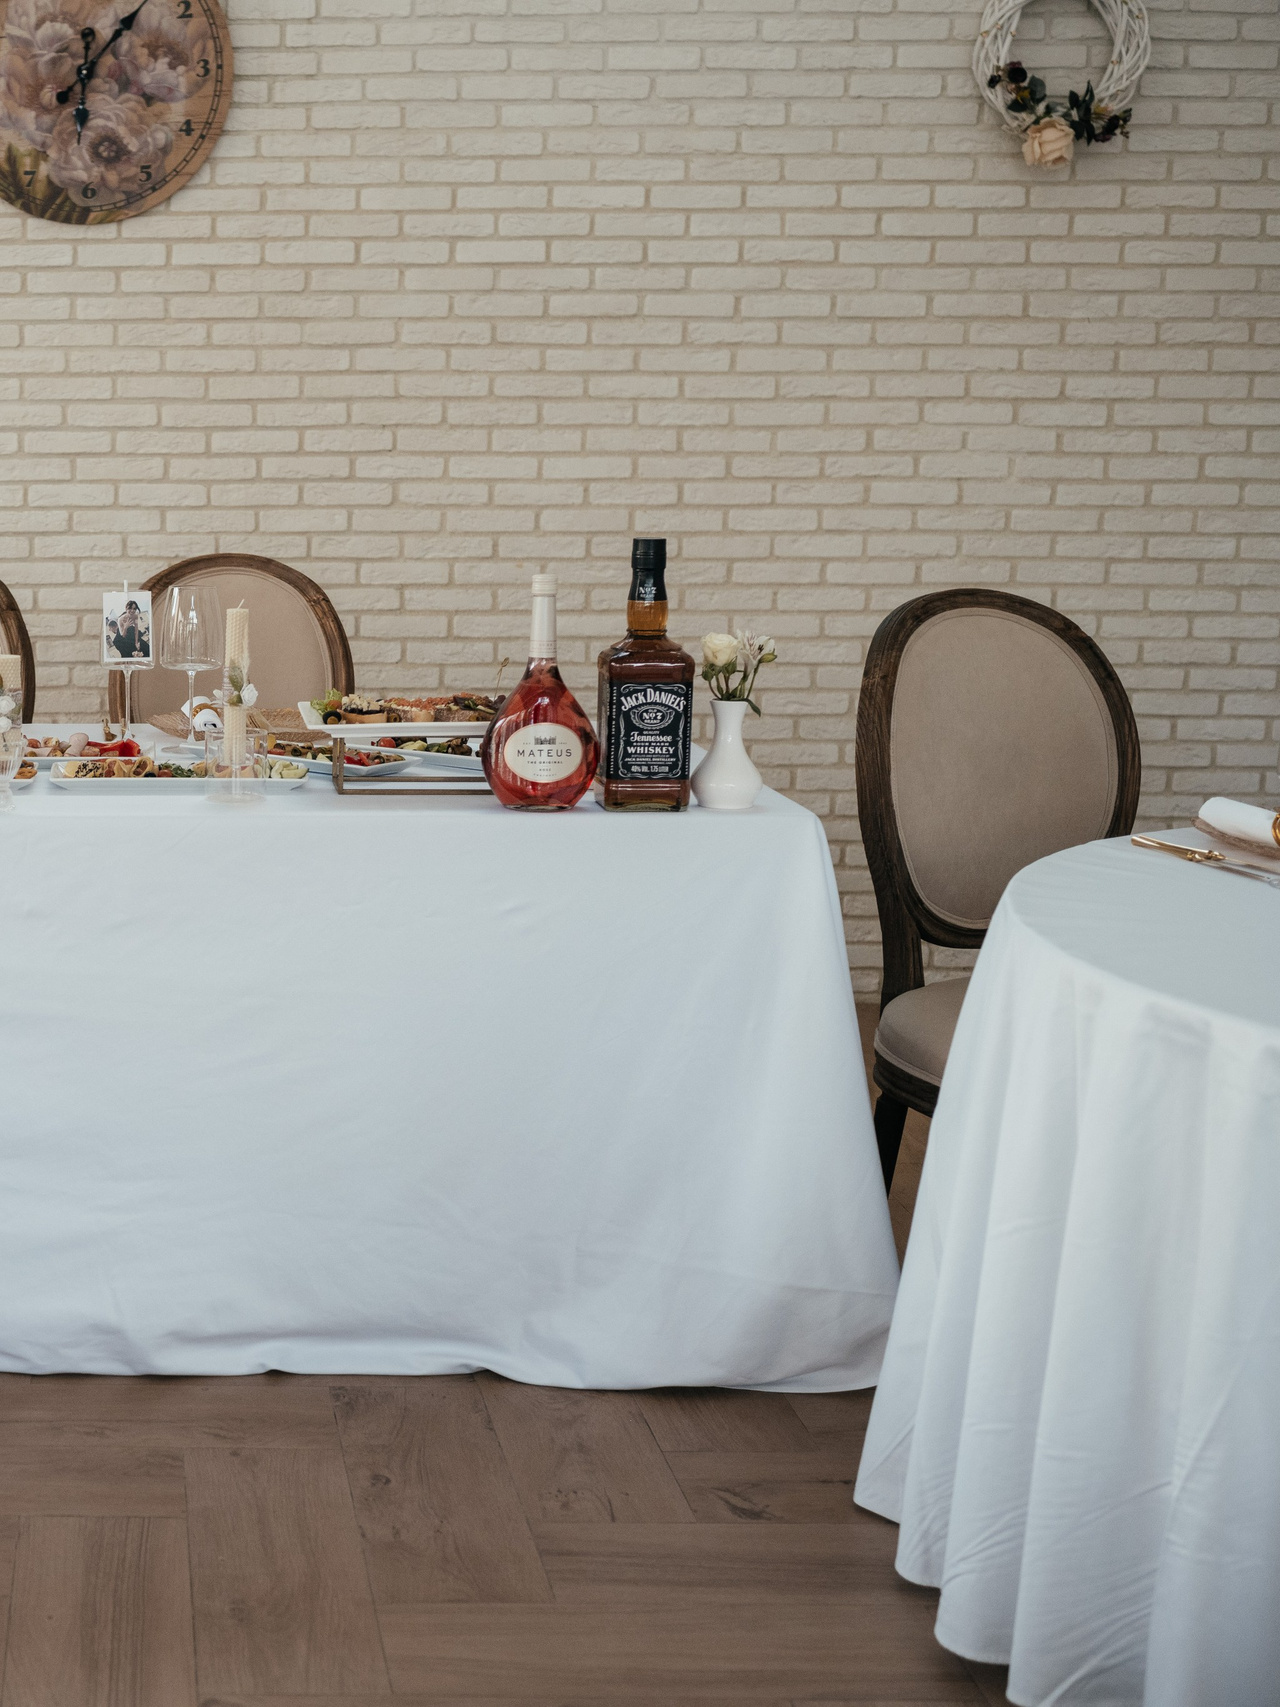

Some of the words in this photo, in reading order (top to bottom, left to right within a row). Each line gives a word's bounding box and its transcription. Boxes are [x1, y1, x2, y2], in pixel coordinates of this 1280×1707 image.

[176, 0, 193, 18] 2
[196, 59, 210, 78] 3
[179, 119, 194, 136] 4
[23, 170, 36, 188] 7
[139, 164, 152, 182] 5
[81, 182, 97, 200] 6
[620, 692, 646, 711] JACK
[646, 688, 686, 712] DANIEL'S
[630, 731, 672, 742] Tennessee
[517, 749, 572, 757] MATEUS
